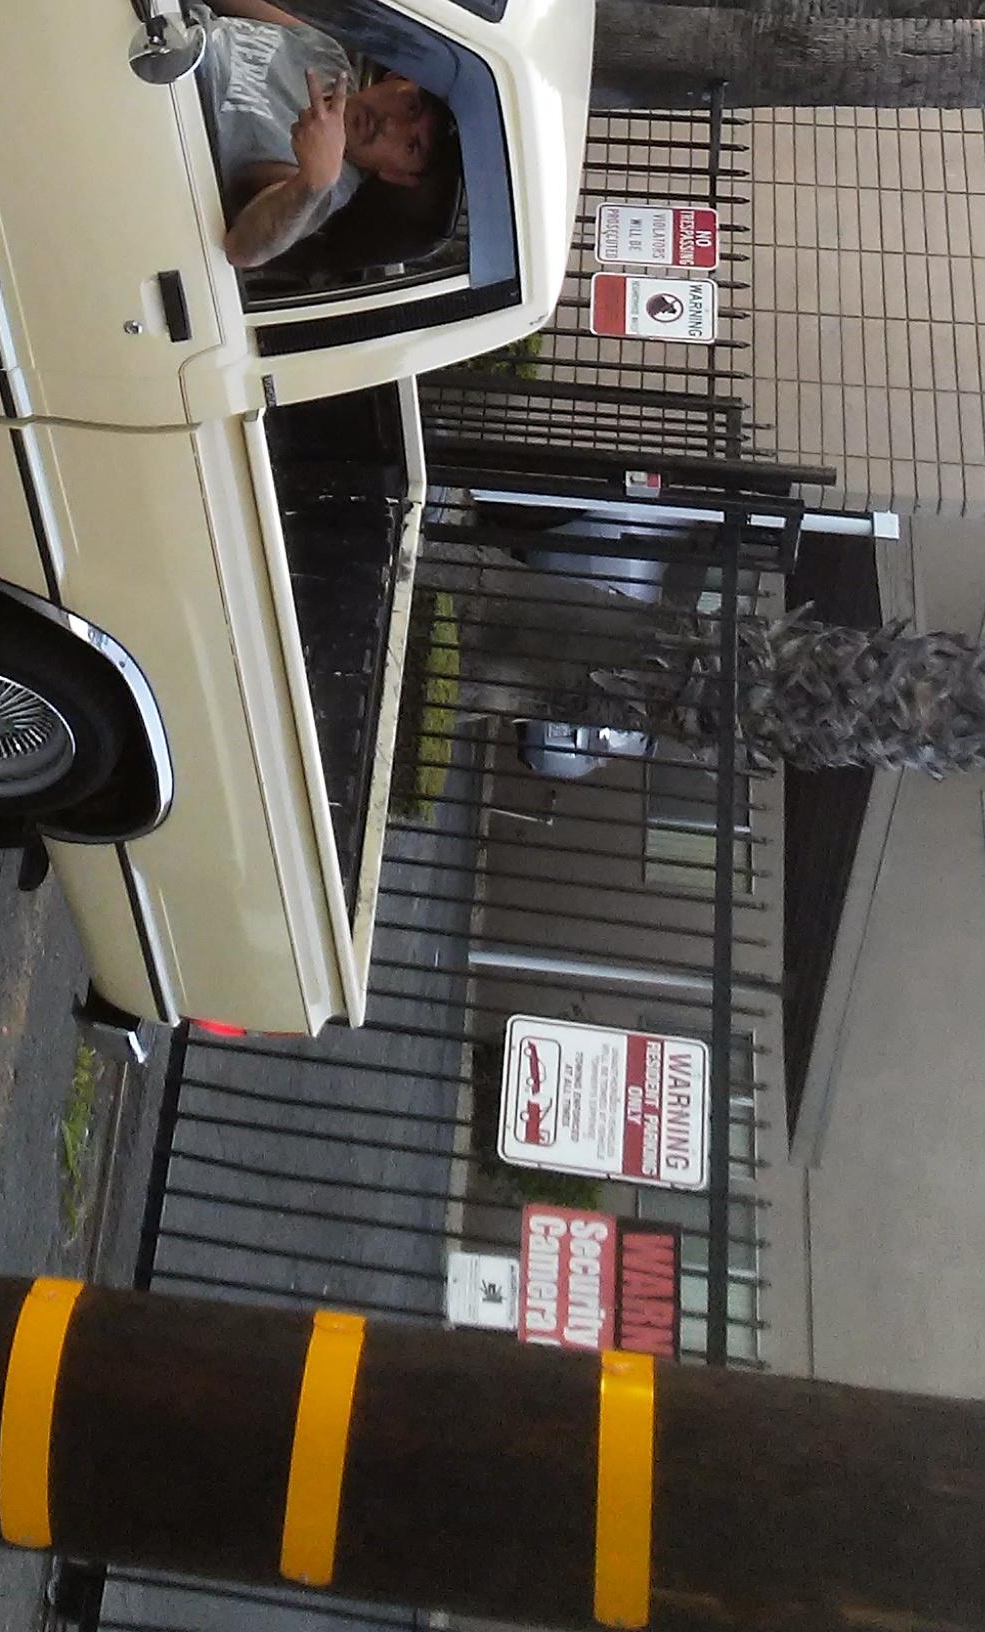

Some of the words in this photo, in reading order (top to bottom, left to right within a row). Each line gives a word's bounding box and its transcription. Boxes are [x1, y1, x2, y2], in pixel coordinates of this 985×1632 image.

[605, 209, 619, 258] PROSECUTED
[629, 219, 642, 237] WILL
[629, 241, 642, 251] BE
[653, 214, 666, 259] VIOLATORS
[679, 211, 695, 265] TRESPASSING
[696, 231, 712, 247] NO
[688, 285, 703, 337] WARNING
[563, 1078, 572, 1094] ALL
[565, 1064, 573, 1076] AT
[574, 1052, 583, 1089] TOWING
[645, 1041, 661, 1107] RESIDENT
[562, 1099, 571, 1128] TIMES
[571, 1091, 582, 1142] ENFORCED
[627, 1086, 642, 1124] ONLY
[666, 1054, 692, 1170] WARNING
[642, 1114, 659, 1176] PARKING
[525, 1215, 567, 1332] Camera
[563, 1220, 609, 1348] Security
